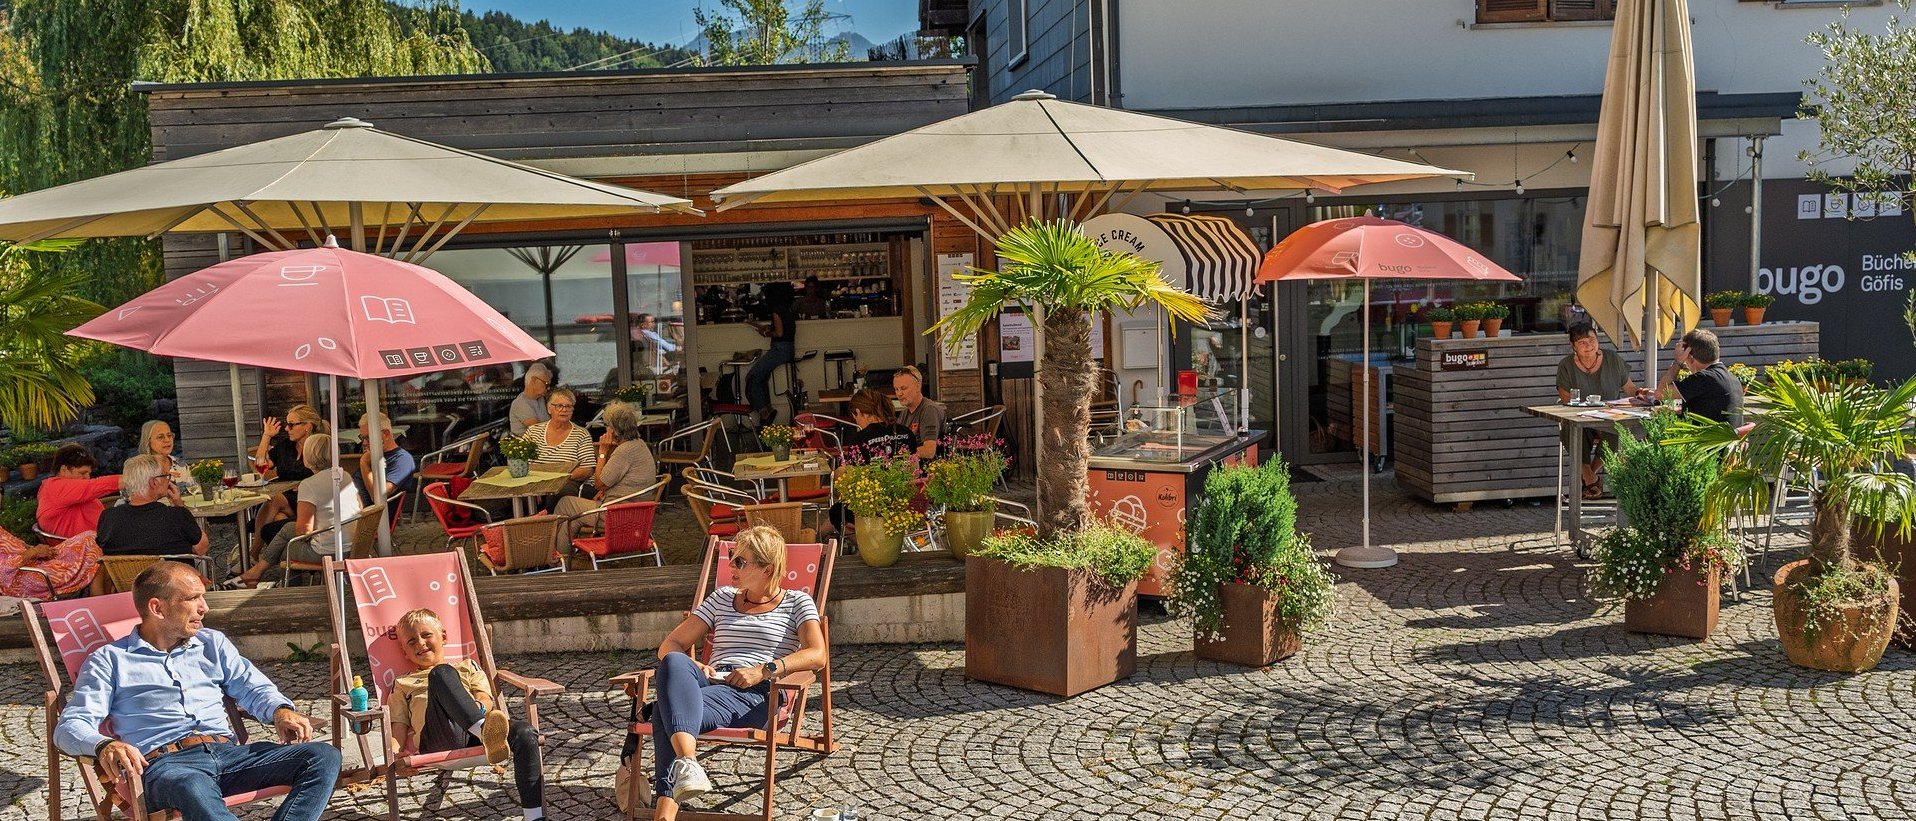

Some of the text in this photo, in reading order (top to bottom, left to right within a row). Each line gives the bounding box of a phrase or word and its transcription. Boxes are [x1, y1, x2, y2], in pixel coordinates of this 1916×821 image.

[1111, 229, 1146, 252] CREAM
[1378, 263, 1412, 274] bugo
[1861, 274, 1904, 292] Göfis
[1445, 353, 1468, 365] bugo
[1157, 492, 1177, 502] Kolibri
[365, 622, 398, 641] bug
